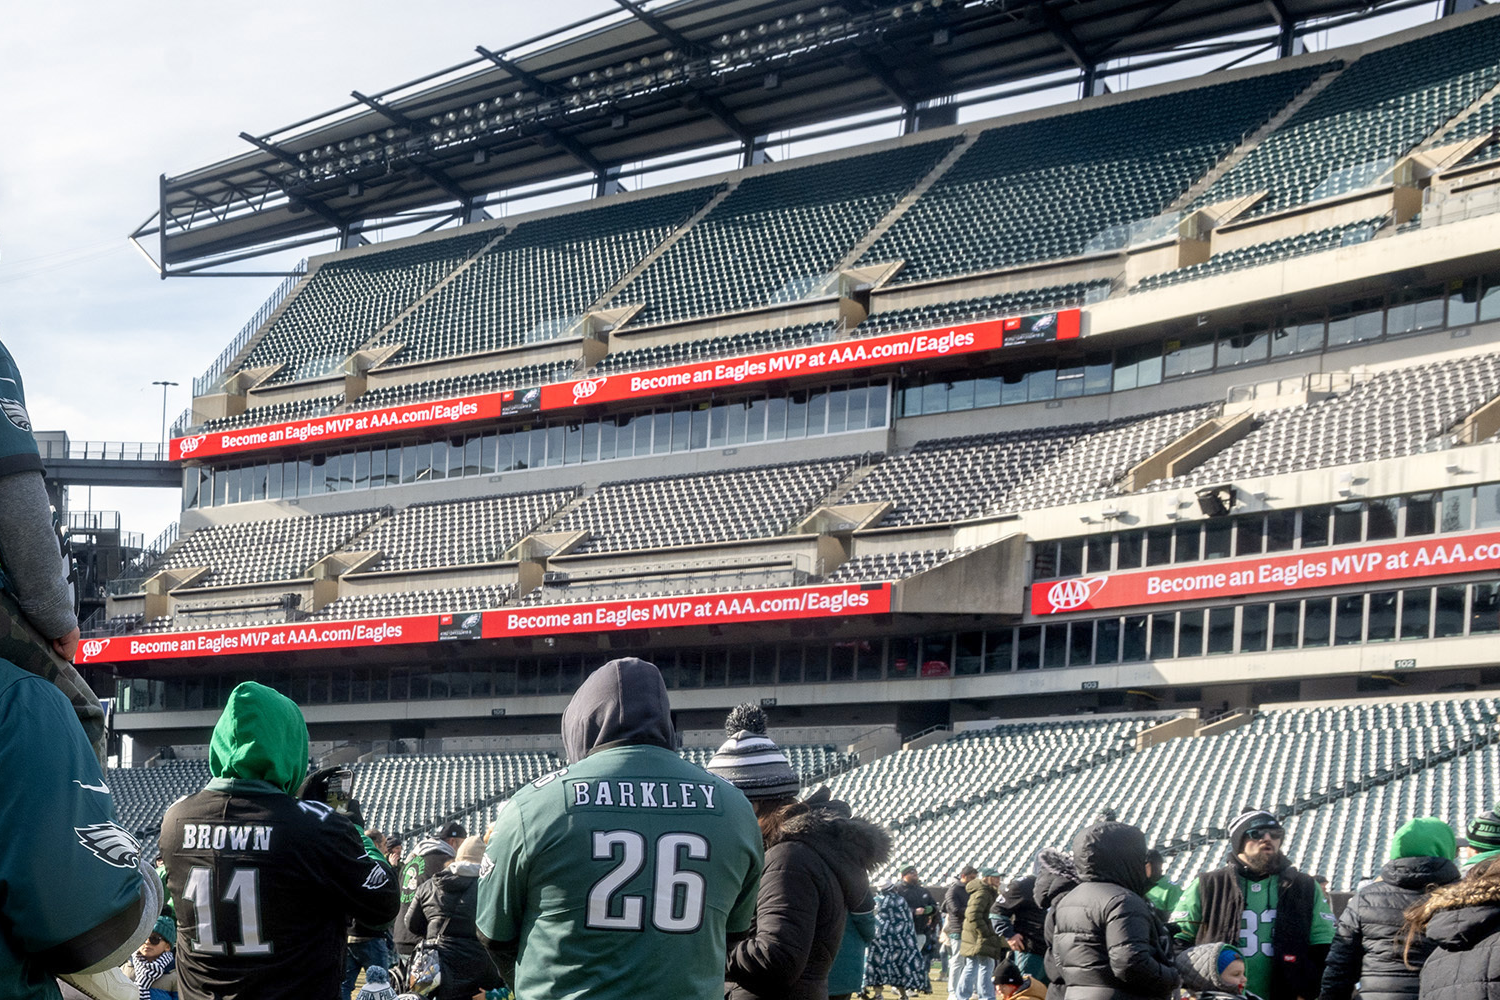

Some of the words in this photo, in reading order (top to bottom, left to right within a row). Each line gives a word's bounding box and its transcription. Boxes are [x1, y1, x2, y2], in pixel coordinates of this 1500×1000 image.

[630, 368, 690, 391] Become
[692, 369, 712, 383] an
[714, 356, 766, 383] Eagles
[769, 354, 806, 372] MVP
[809, 352, 825, 366] at
[828, 329, 974, 365] AAA.com/Eagles
[221, 433, 267, 449] Become
[269, 431, 283, 441] an
[285, 425, 324, 441] Eagles
[326, 418, 354, 434] MVP
[355, 418, 369, 429] at
[370, 401, 477, 427] AAA.com/Eagles
[1048, 581, 1089, 606] AAA
[1147, 574, 1226, 595] Become
[1230, 571, 1254, 586] an
[1258, 561, 1327, 584] Eagles
[1332, 552, 1382, 574] MVP
[1386, 551, 1408, 569] at
[507, 613, 570, 630] Become
[573, 613, 593, 625] an
[596, 606, 650, 626] Eagles
[653, 603, 692, 619] MVP
[695, 602, 712, 617] at
[715, 589, 869, 616] AAA.com/Eagles
[130, 641, 178, 654] Become
[180, 640, 196, 650] an
[197, 635, 239, 652] Eagles
[240, 632, 270, 646] MVP
[272, 632, 286, 644] at
[287, 623, 402, 644] AAA.com/Eagles
[1396, 659, 1415, 668] 102
[573, 781, 715, 809] BARKLEY
[183, 824, 273, 850] BROWN
[585, 829, 711, 935] 26
[182, 866, 273, 957] 11
